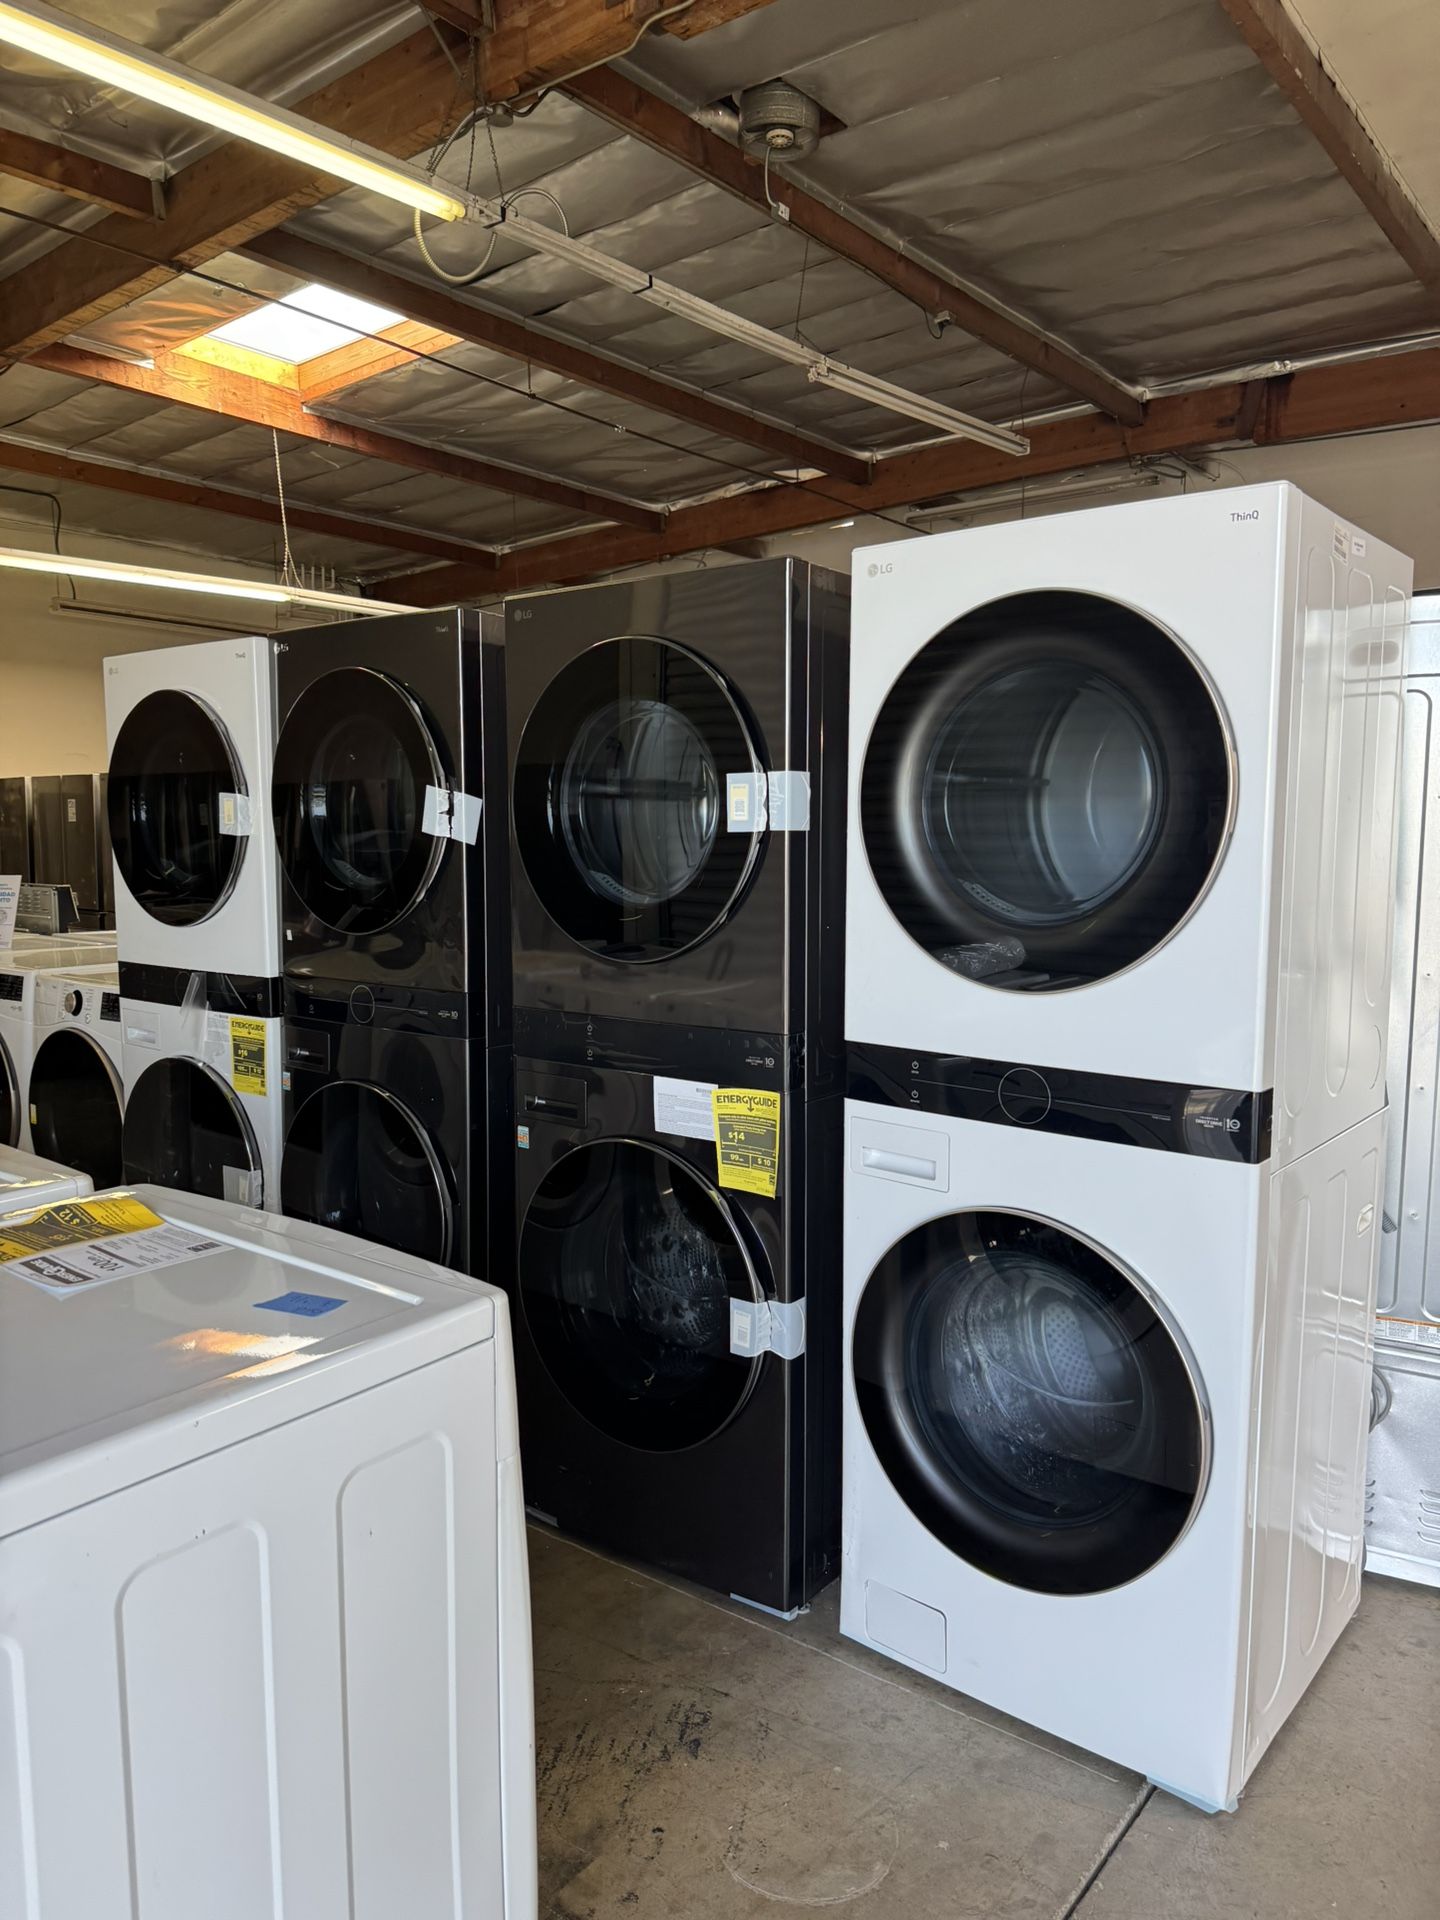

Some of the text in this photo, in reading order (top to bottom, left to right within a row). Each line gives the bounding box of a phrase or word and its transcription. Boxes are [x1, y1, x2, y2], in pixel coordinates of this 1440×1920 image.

[1230, 510, 1259, 522] ThinQ
[880, 563, 893, 574] LG
[523, 611, 532, 619] LG
